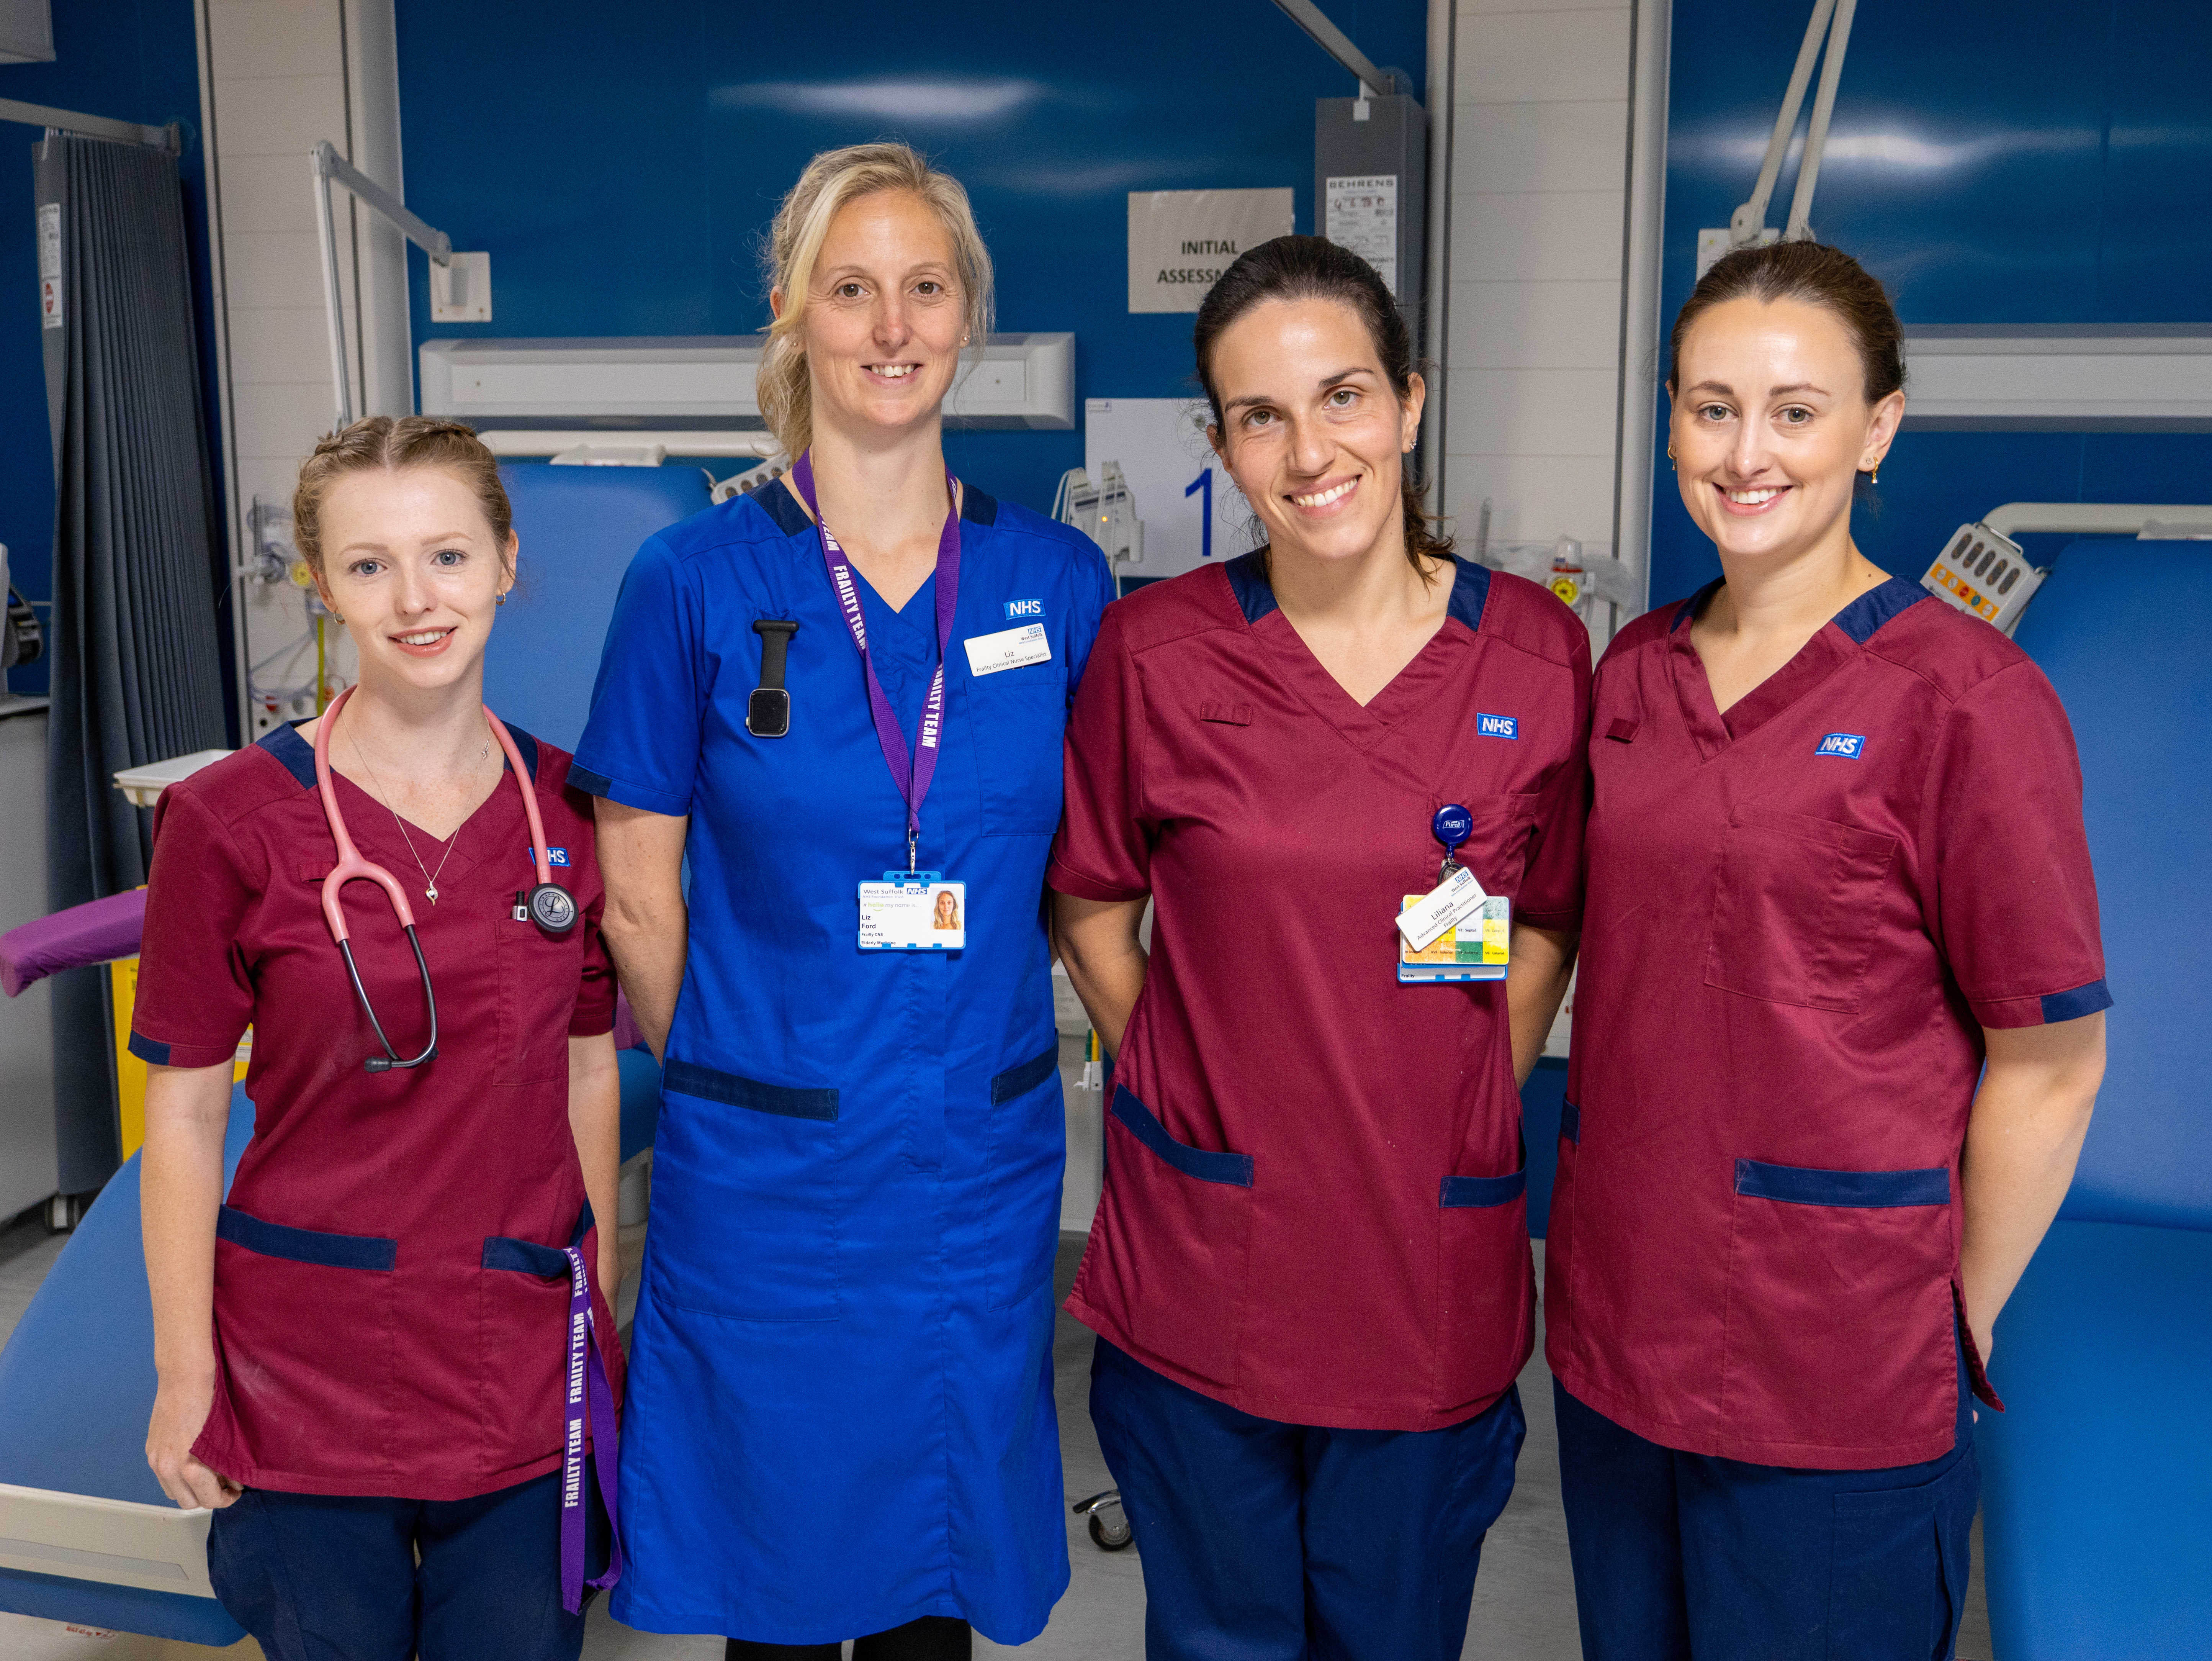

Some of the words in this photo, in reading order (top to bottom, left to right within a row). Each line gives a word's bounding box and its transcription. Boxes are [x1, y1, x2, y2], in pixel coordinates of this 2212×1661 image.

[1329, 179, 1394, 188] BEHRENS
[1181, 240, 1238, 254] INITIAL
[1185, 468, 1212, 557] 1
[833, 565, 859, 613] FRAILTY
[850, 613, 866, 650] TEAM
[1009, 600, 1041, 616] NHS
[1025, 652, 1047, 661] Specialist
[922, 713, 939, 748] TEAM
[1482, 717, 1513, 735] NHS
[1820, 737, 1857, 754] NHS
[547, 849, 566, 863] HS
[1455, 871, 1468, 883] NHS
[1459, 876, 1471, 886] Suffolk
[1417, 922, 1438, 940] Advanced
[1438, 911, 1453, 924] Clinical
[1453, 893, 1477, 913] Practitioner
[1431, 902, 1454, 920] Liliana
[1443, 916, 1457, 928] Frailty
[563, 1248, 583, 1298] FRAILTY
[573, 1312, 584, 1350] TEAM
[569, 1352, 584, 1404] FRAILTY
[569, 1418, 582, 1455] TEAM
[565, 1457, 581, 1508] FRAILTY
